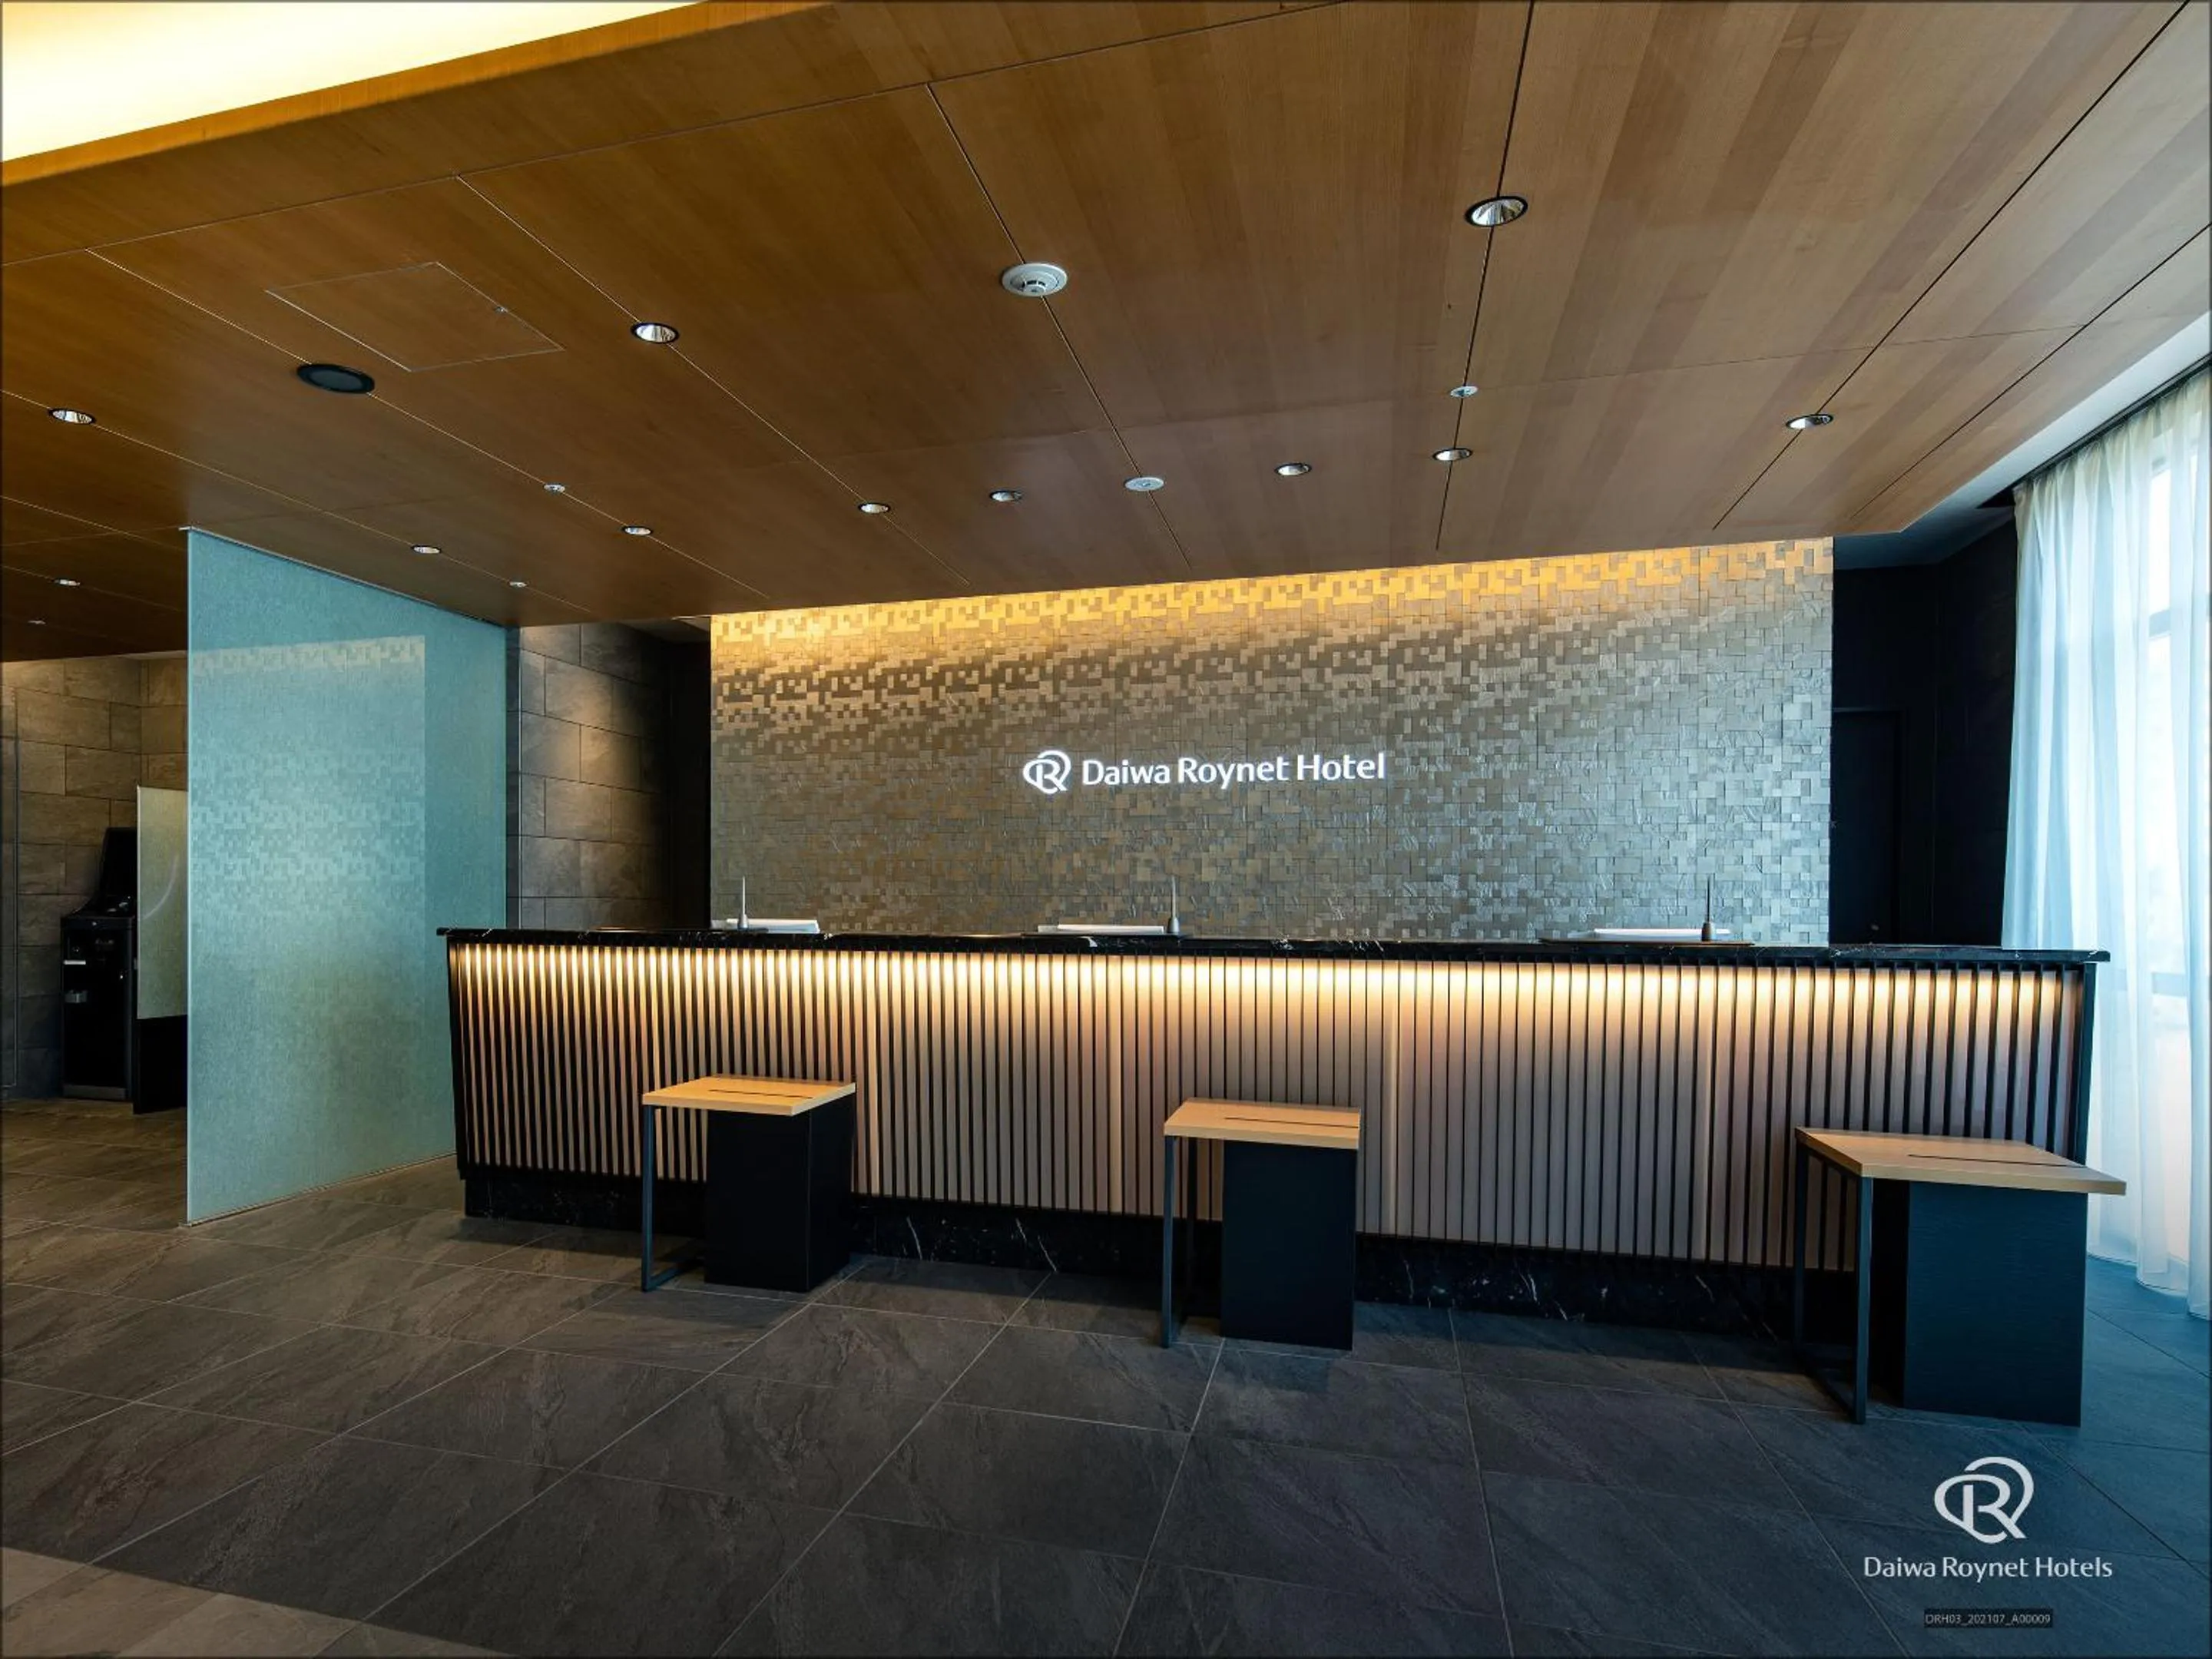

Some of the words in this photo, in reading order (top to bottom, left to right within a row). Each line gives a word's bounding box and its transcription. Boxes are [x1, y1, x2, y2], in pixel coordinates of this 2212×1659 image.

[1081, 760, 1171, 786] Daiwa
[1177, 757, 1290, 790] Roynet
[1296, 753, 1386, 781] Hotel
